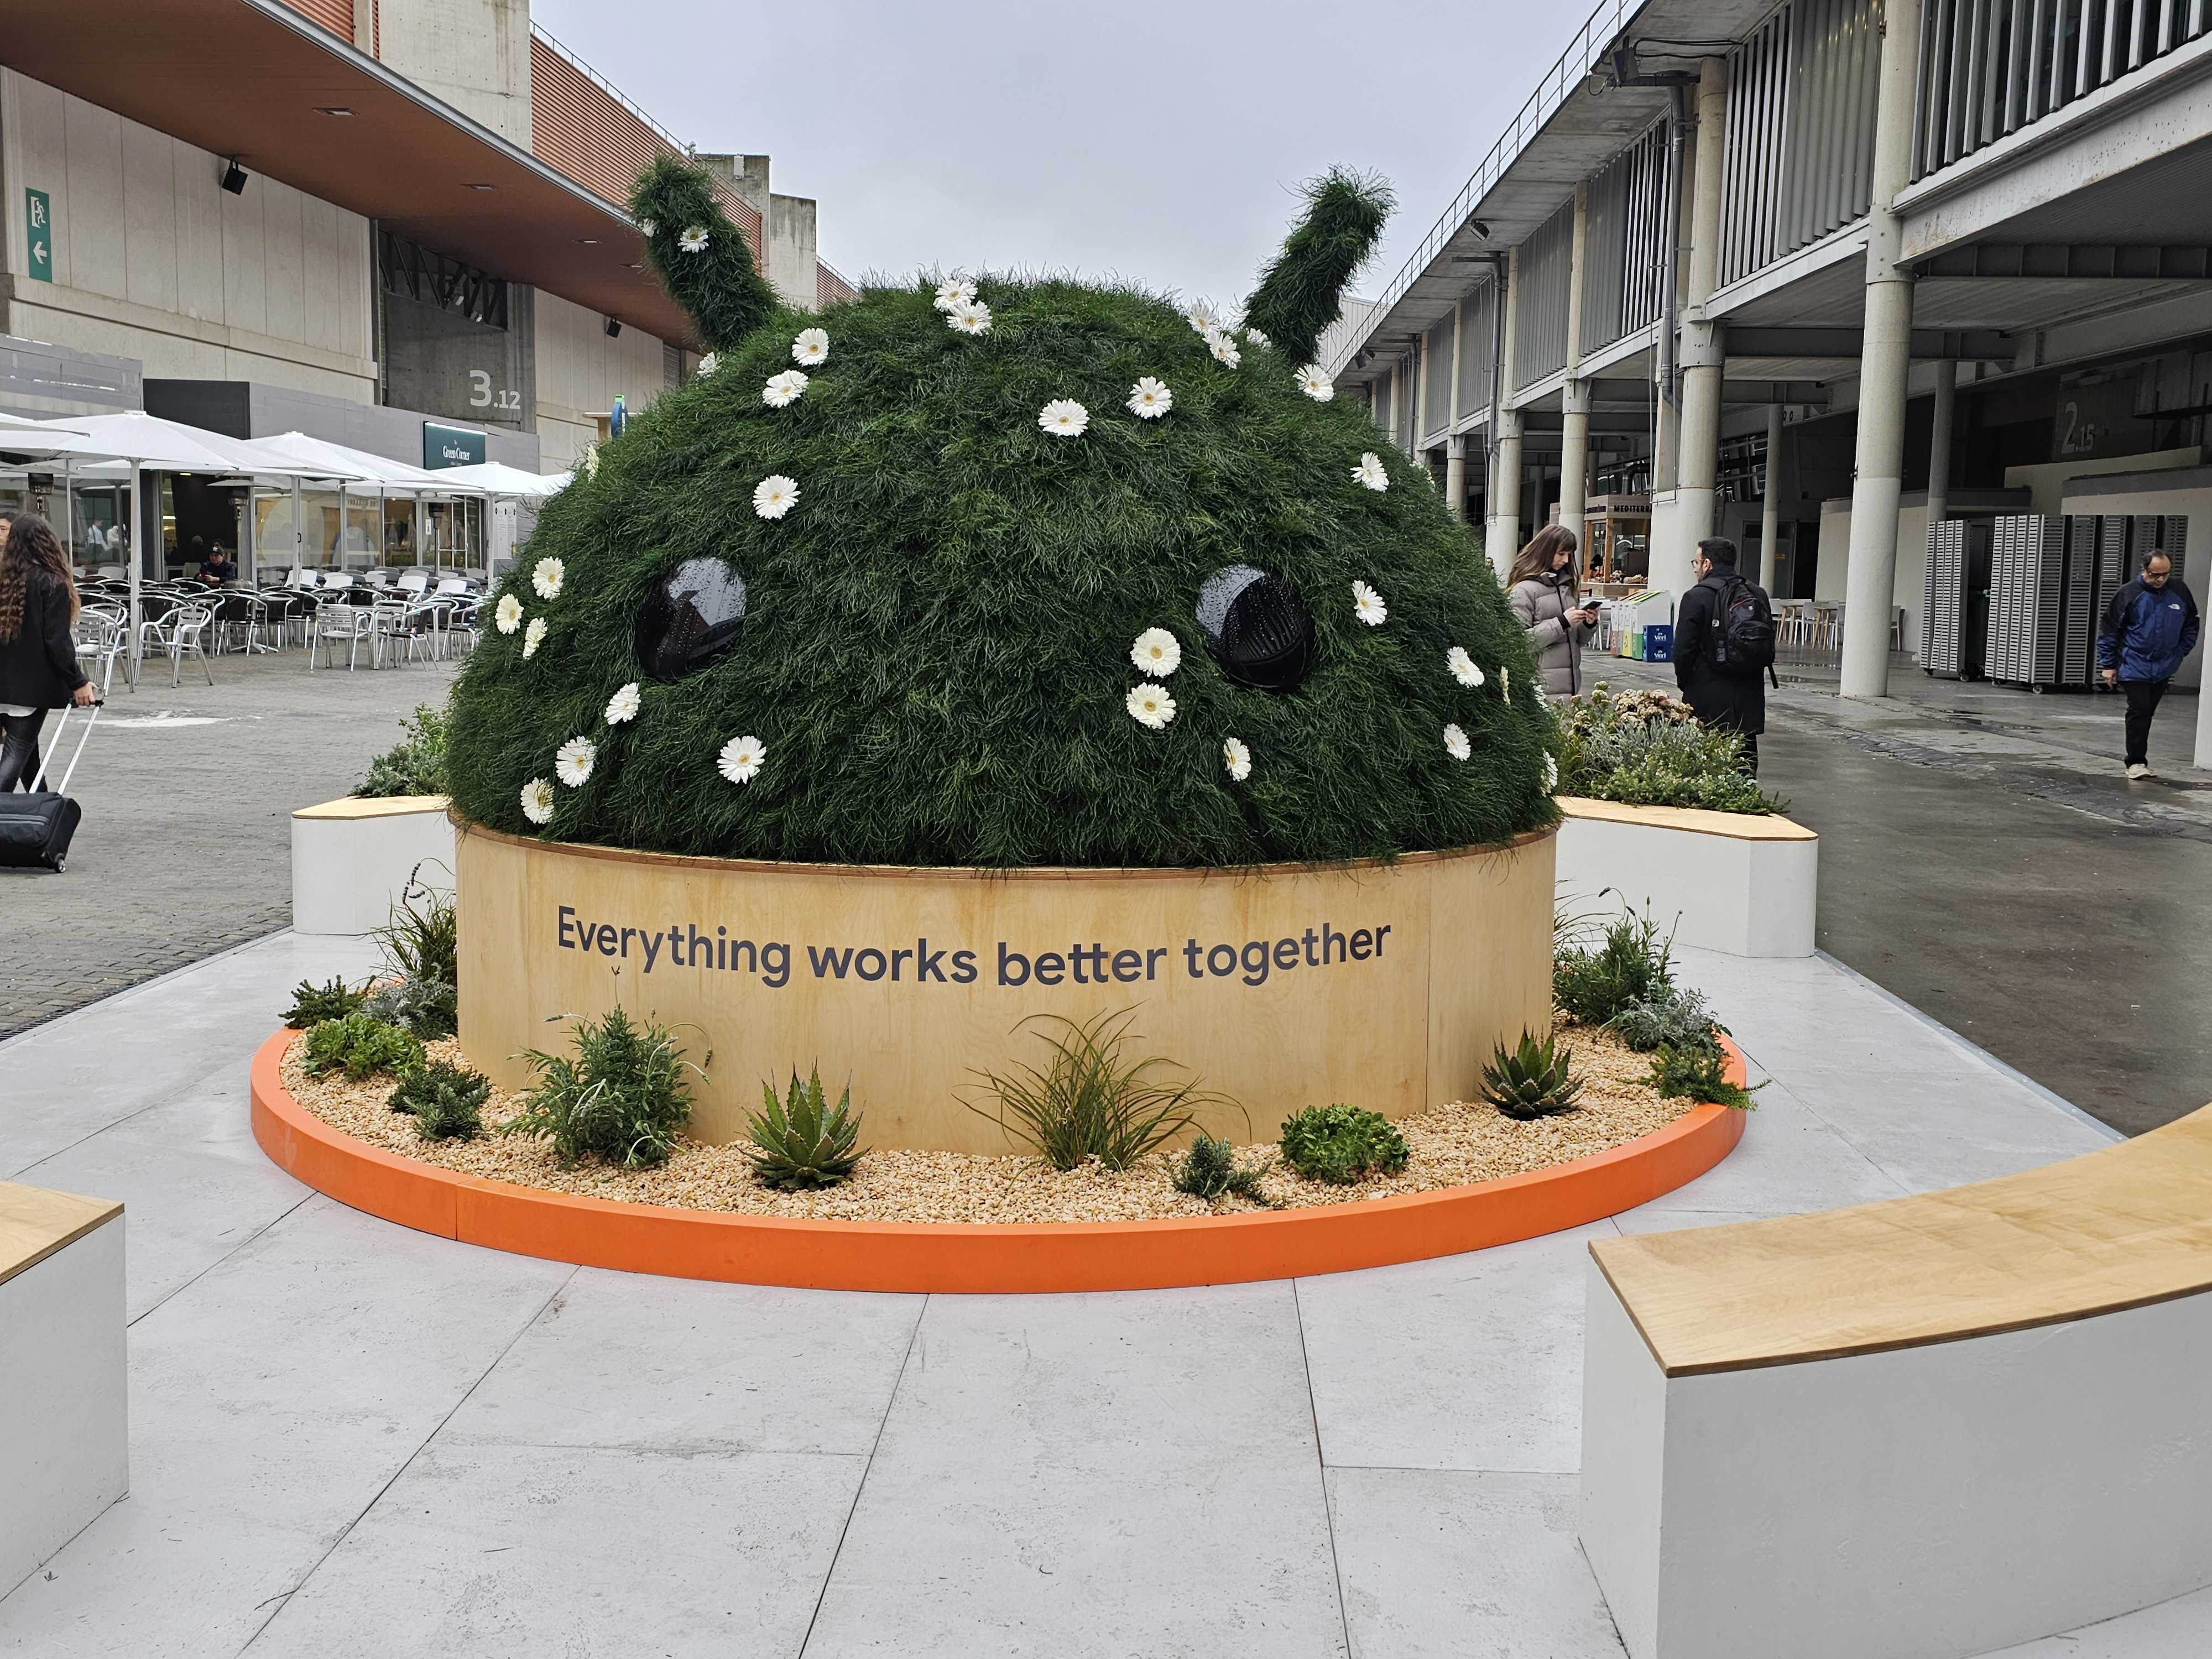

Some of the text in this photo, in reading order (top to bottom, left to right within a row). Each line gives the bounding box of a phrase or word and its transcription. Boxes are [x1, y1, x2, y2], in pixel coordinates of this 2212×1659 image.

[470, 370, 520, 409] 3.12
[2061, 401, 2095, 454] 2.15
[442, 445, 470, 460] Green Corner
[559, 907, 1391, 988] Everything works better together
